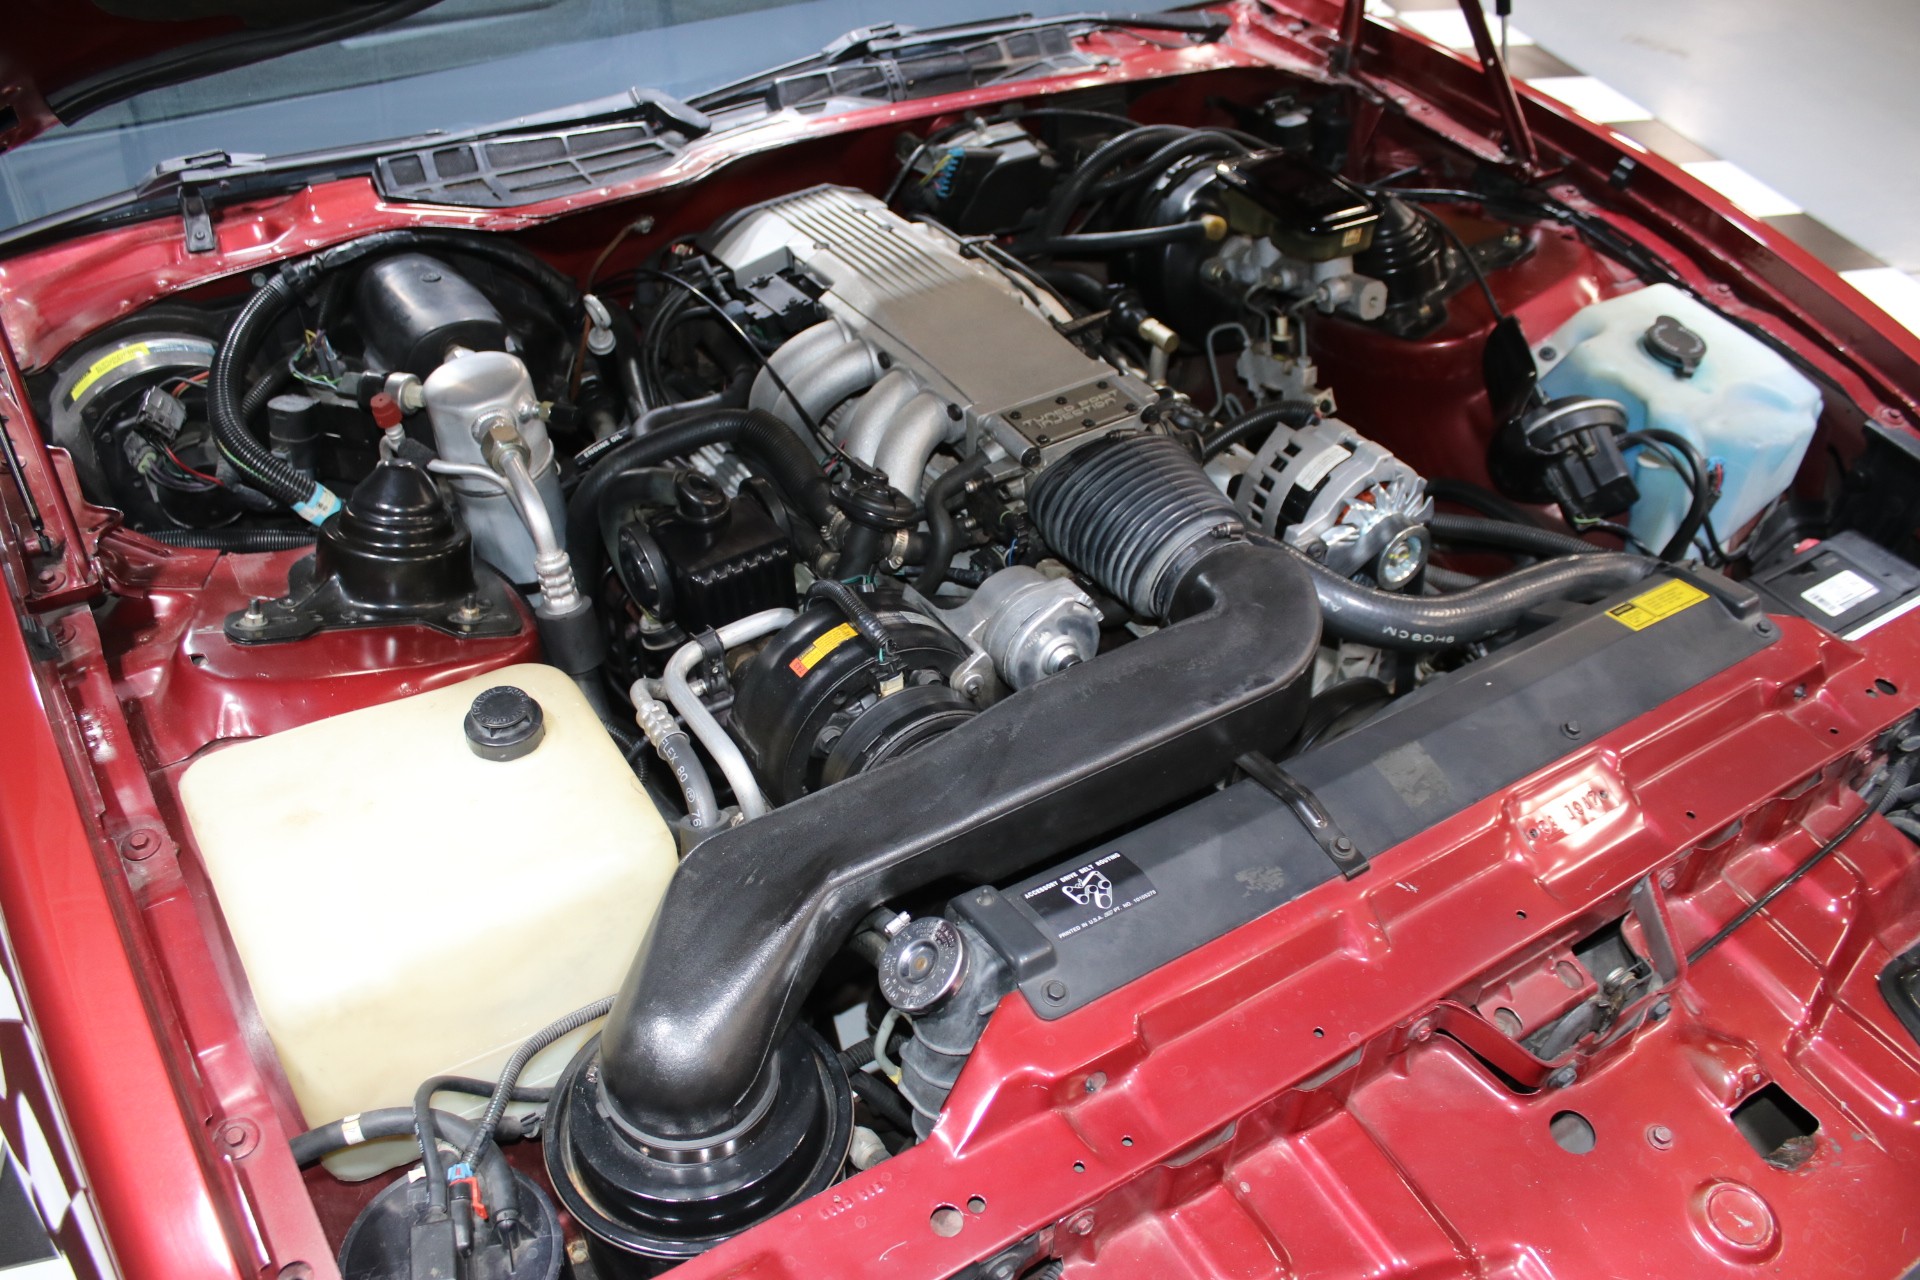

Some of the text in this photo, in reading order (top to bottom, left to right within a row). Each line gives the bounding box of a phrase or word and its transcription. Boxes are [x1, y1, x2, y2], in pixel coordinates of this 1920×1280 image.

[1022, 389, 1119, 427] TUNED PORT
[1035, 398, 1117, 429] INJECTION
[583, 433, 623, 458] ENGINE OIL
[676, 765, 688, 783] 80
[1024, 852, 1121, 899] ACCESSORY DRIVE BELT ROUTING
[1058, 925, 1081, 939] PRINTED
